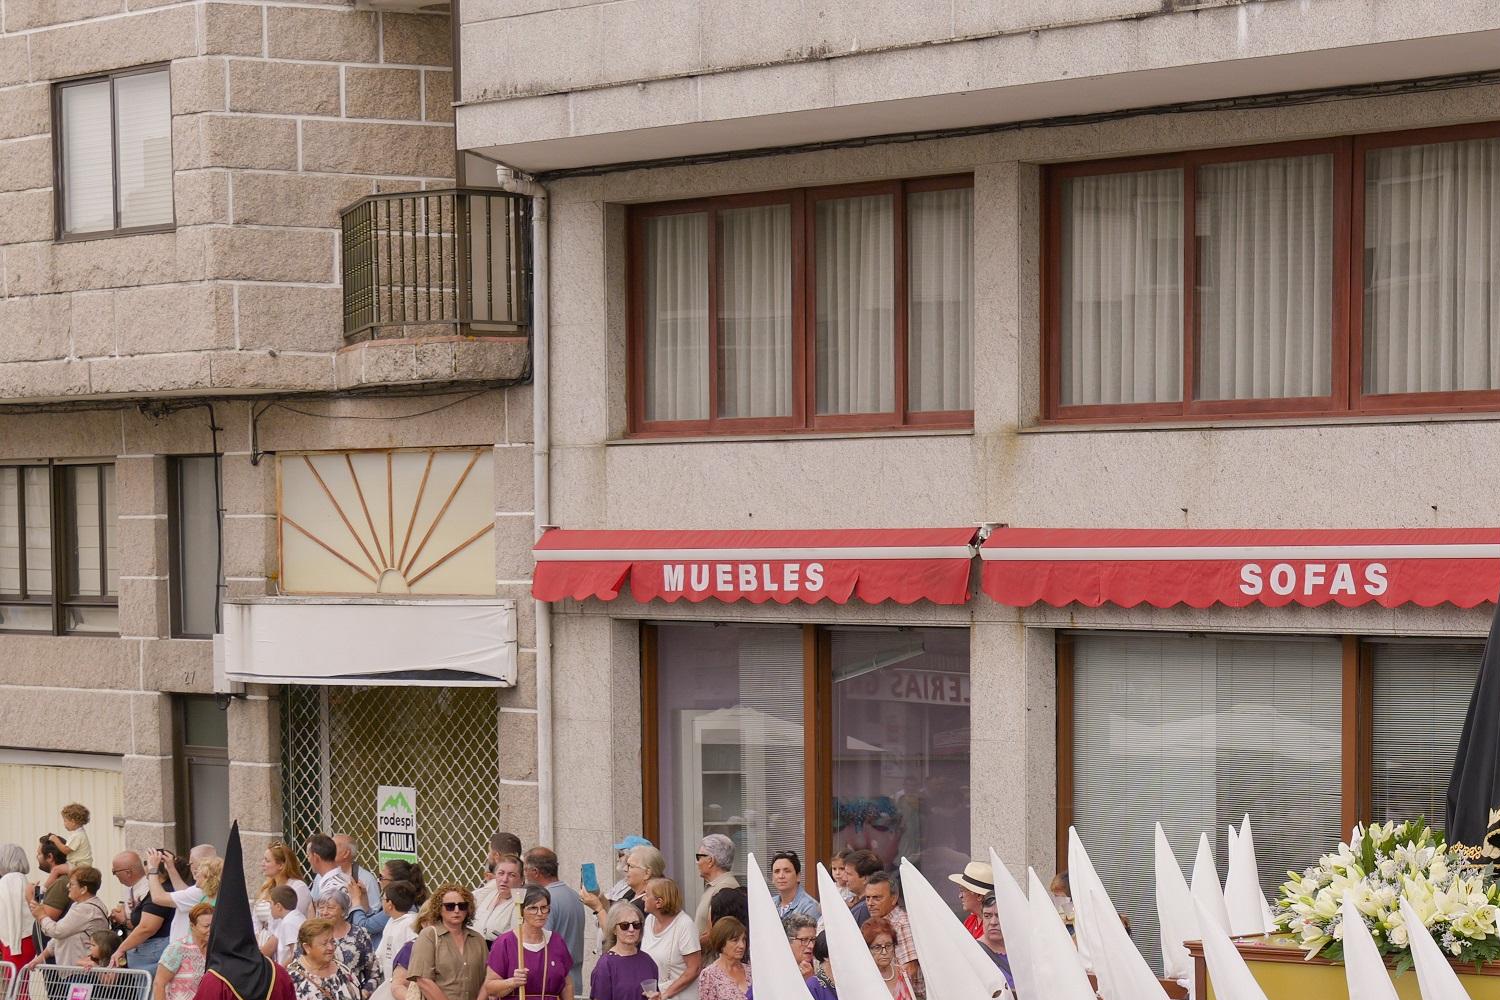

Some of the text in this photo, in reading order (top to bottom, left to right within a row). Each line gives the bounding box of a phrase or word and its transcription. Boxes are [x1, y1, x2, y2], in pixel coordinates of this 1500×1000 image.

[663, 563, 825, 592] MUEBLES
[1239, 563, 1388, 596] SOFAS
[379, 812, 414, 830] rodespi
[381, 833, 414, 852] ALQUILA
